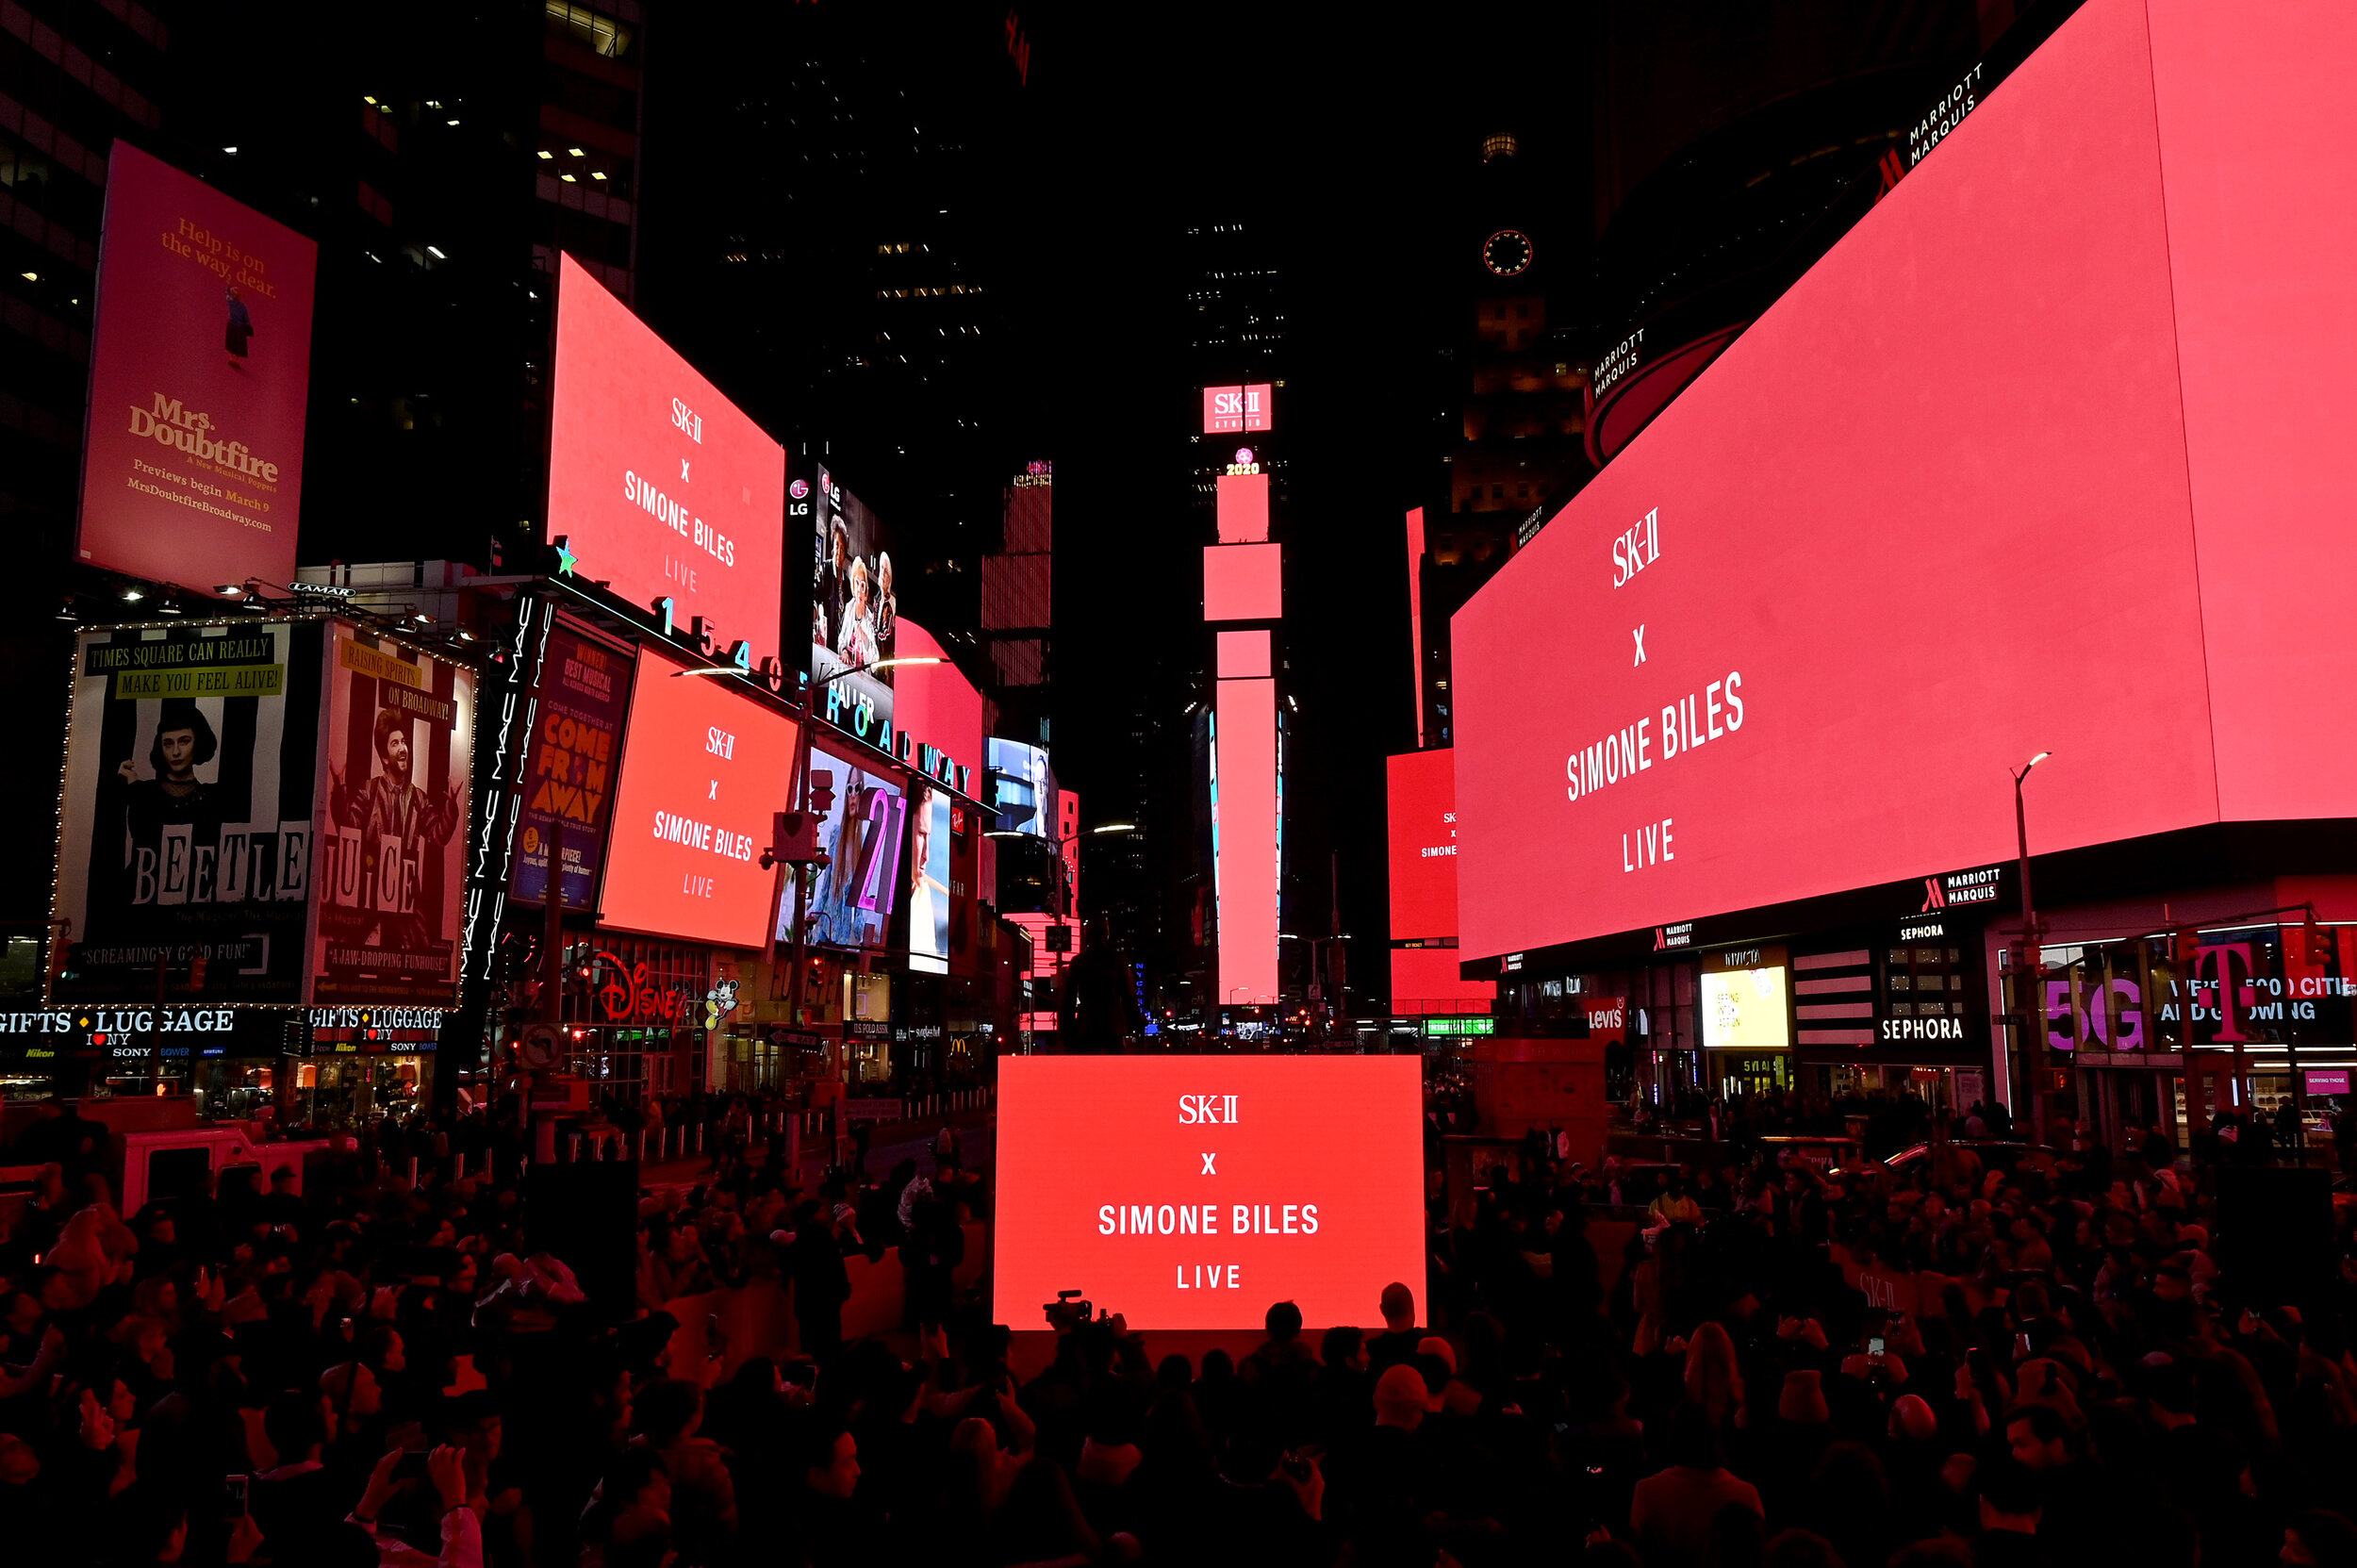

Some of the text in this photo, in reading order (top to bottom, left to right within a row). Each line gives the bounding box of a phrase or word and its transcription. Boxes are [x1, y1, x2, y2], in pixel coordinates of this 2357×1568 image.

[1910, 62, 1983, 145] MARRIOTT
[1911, 94, 1974, 166] MARQUIS
[178, 218, 265, 273] Help is on
[161, 231, 277, 300] the way, dear.
[1594, 328, 1644, 381] MARRIOTT
[1595, 352, 1638, 399] MARQUIS
[152, 391, 215, 431] Mrs.
[672, 397, 702, 444] SK-II
[128, 404, 279, 483] Doubtfire
[133, 458, 271, 514] Previews begin March 9
[1227, 462, 1260, 476] 2020
[127, 477, 272, 534] MrsDoubtfireBroadway.com
[625, 470, 734, 567] SIMONE BILES
[789, 503, 808, 516] LG
[1612, 506, 1661, 589] SK-II
[293, 584, 350, 596] LAMAR
[665, 554, 697, 593] LIVE
[91, 637, 270, 668] TIMES SQUARE CAN REALLY
[348, 646, 416, 686] RAISING SPIRITS
[122, 669, 278, 693] MAKE YOU FEEL ALIVE!
[565, 658, 611, 693] BEST MUSICAL
[388, 685, 449, 720] ON BROADWAY!
[548, 701, 614, 732] COME TOGETHER AT
[544, 714, 612, 762] COME
[705, 726, 734, 760] SK-II
[1567, 670, 1743, 802] SIMONE BILES
[531, 779, 602, 824] AWAY
[653, 810, 752, 862] SIMONE BILES
[1421, 845, 1457, 857] SIMONE
[1623, 818, 1674, 873] LIVE
[131, 830, 306, 905] BEETLE
[1948, 868, 2001, 888] MARRIOTT
[683, 873, 714, 898] LIVE
[1949, 885, 1995, 903] MARQUIS
[1666, 923, 1692, 935] MARRIOTT
[1666, 935, 1690, 947] MARQUIS
[1901, 924, 1944, 940] SEPHORA
[177, 946, 212, 961] GOD
[339, 949, 402, 968] JAW-DROPPING
[1724, 949, 1761, 966] INVICTA
[94, 1010, 234, 1033] LUGGAGE
[309, 1009, 443, 1030] GIFTS LUGGAGE
[1883, 1017, 1963, 1039] SEPHORA
[2046, 979, 2144, 1050] 5G
[25, 1048, 56, 1058] Nikon
[112, 1048, 152, 1057] SONY
[336, 1043, 356, 1052] Nikon
[390, 1043, 417, 1051] SONY
[1178, 1095, 1239, 1124] SK-II
[1098, 1204, 1319, 1235] SIMONE BILES
[1177, 1265, 1241, 1289] LIVE
